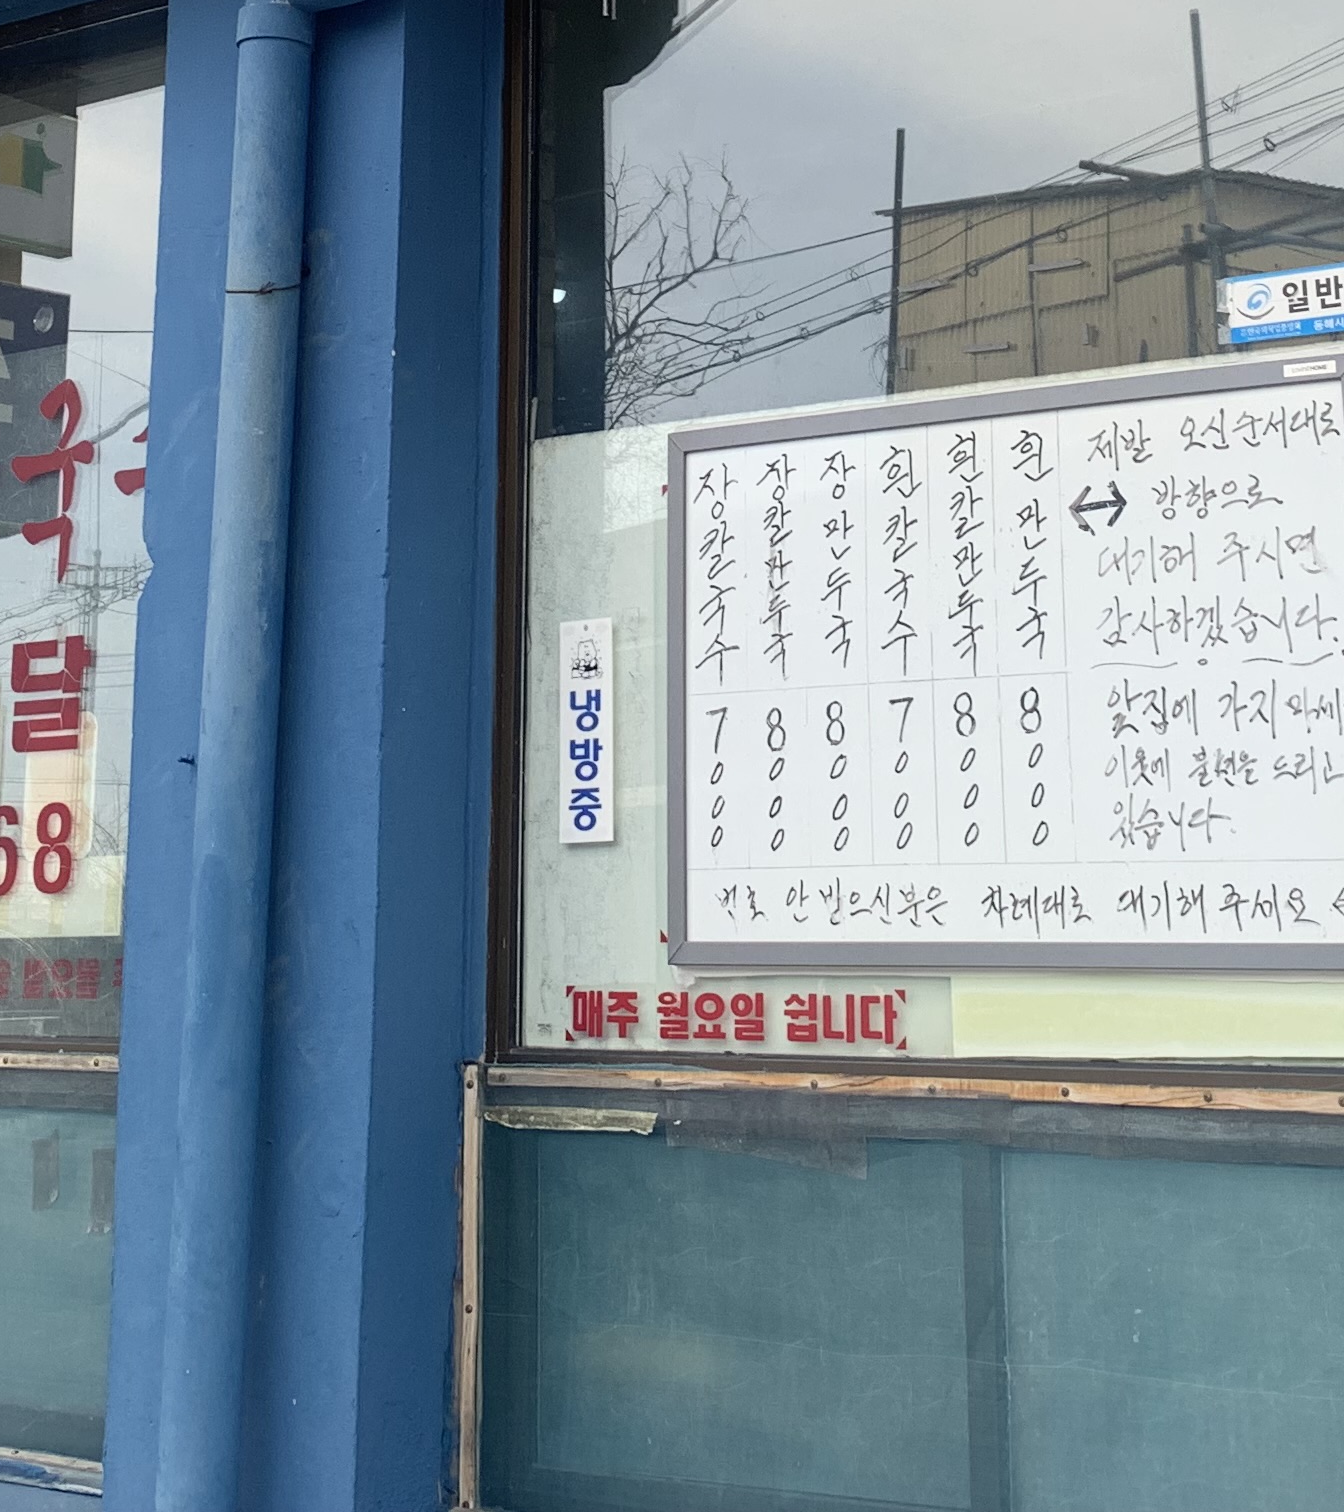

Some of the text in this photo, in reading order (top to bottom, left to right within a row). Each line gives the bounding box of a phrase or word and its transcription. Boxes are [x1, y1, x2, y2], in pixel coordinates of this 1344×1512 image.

[1087, 419, 1153, 471] 제발
[1154, 474, 1283, 519] 방향으로
[1216, 525, 1328, 581] 주시면
[1219, 678, 1277, 739] 가지
[568, 688, 603, 832] 냉방중
[1105, 744, 1172, 791] 이웃에
[1188, 745, 1259, 788] 불편을
[981, 885, 1092, 939] 차례대로
[572, 990, 897, 1045] 매주 월요일 쉽니다
